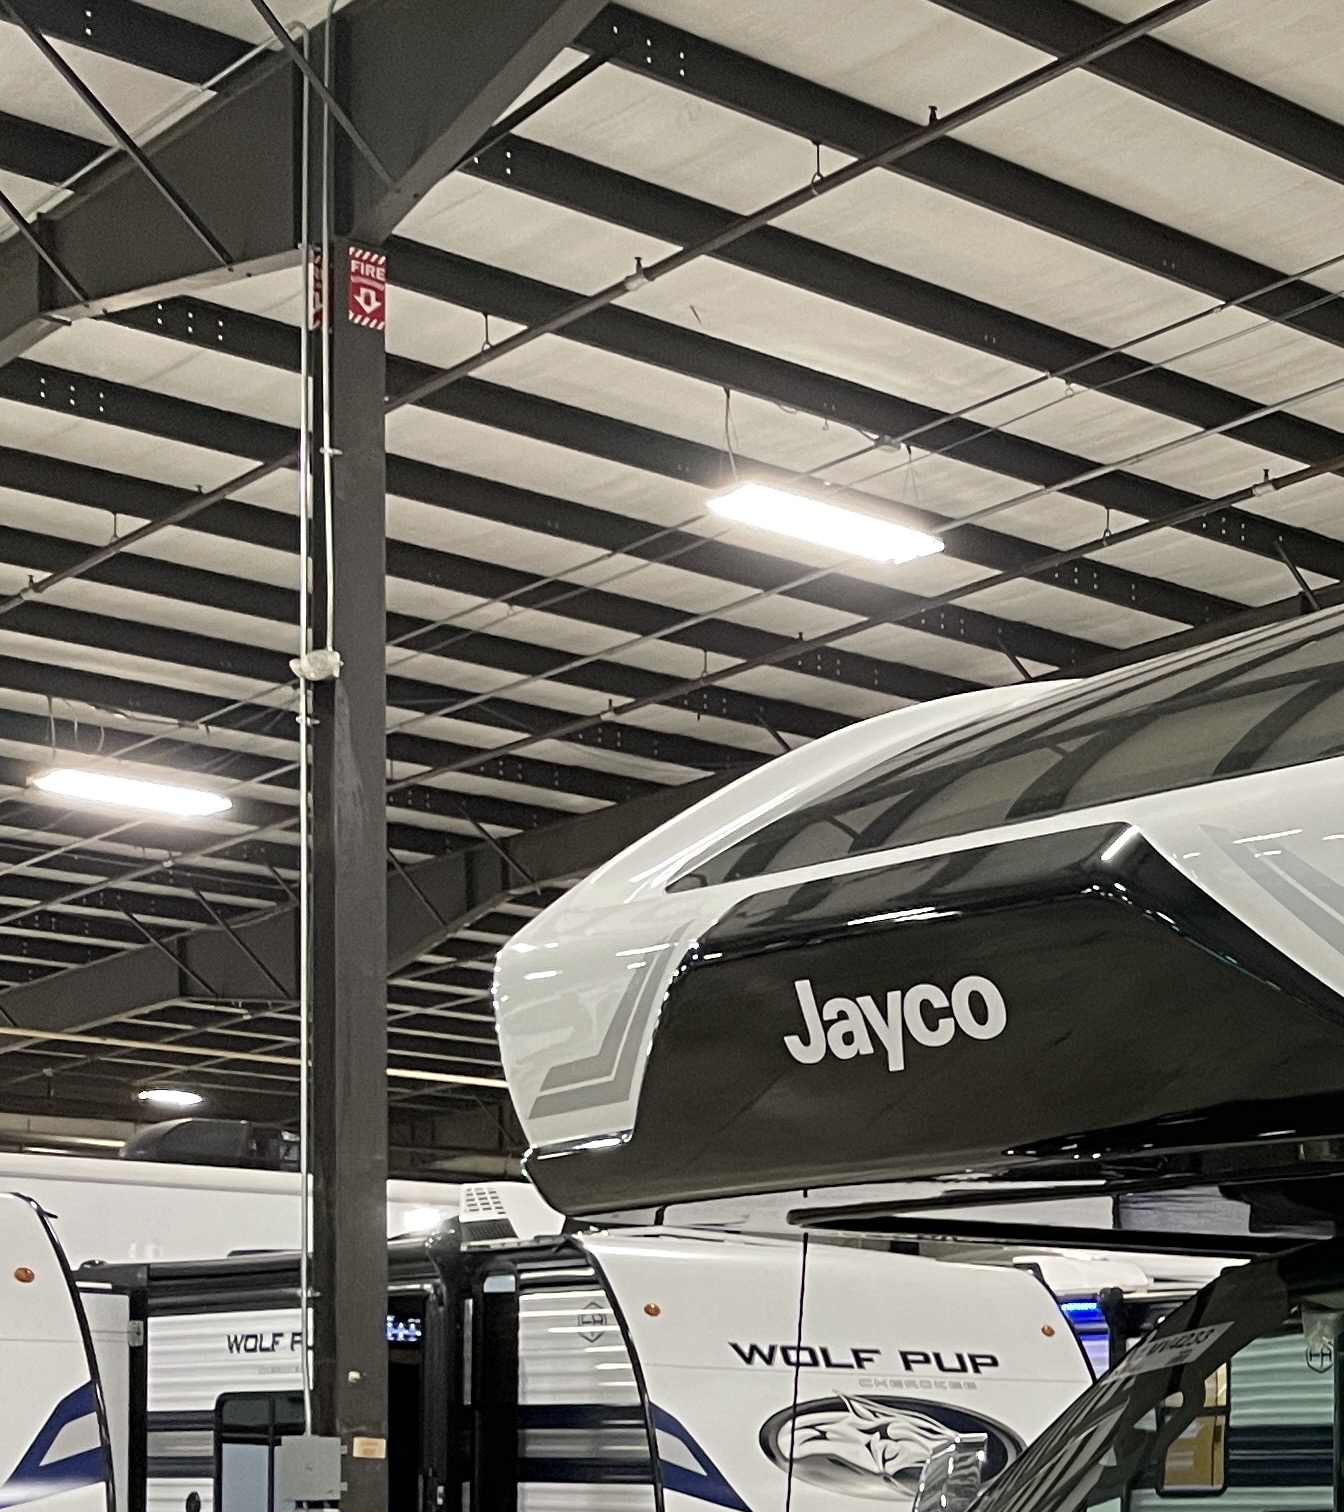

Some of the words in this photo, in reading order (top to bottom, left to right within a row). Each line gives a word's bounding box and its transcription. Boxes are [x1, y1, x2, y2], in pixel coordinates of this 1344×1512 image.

[351, 260, 385, 281] FIRE
[783, 975, 1007, 1072] Jayco
[227, 1332, 284, 1354] WOLF
[728, 1342, 882, 1369] WOLF
[898, 1349, 999, 1374] PUP
